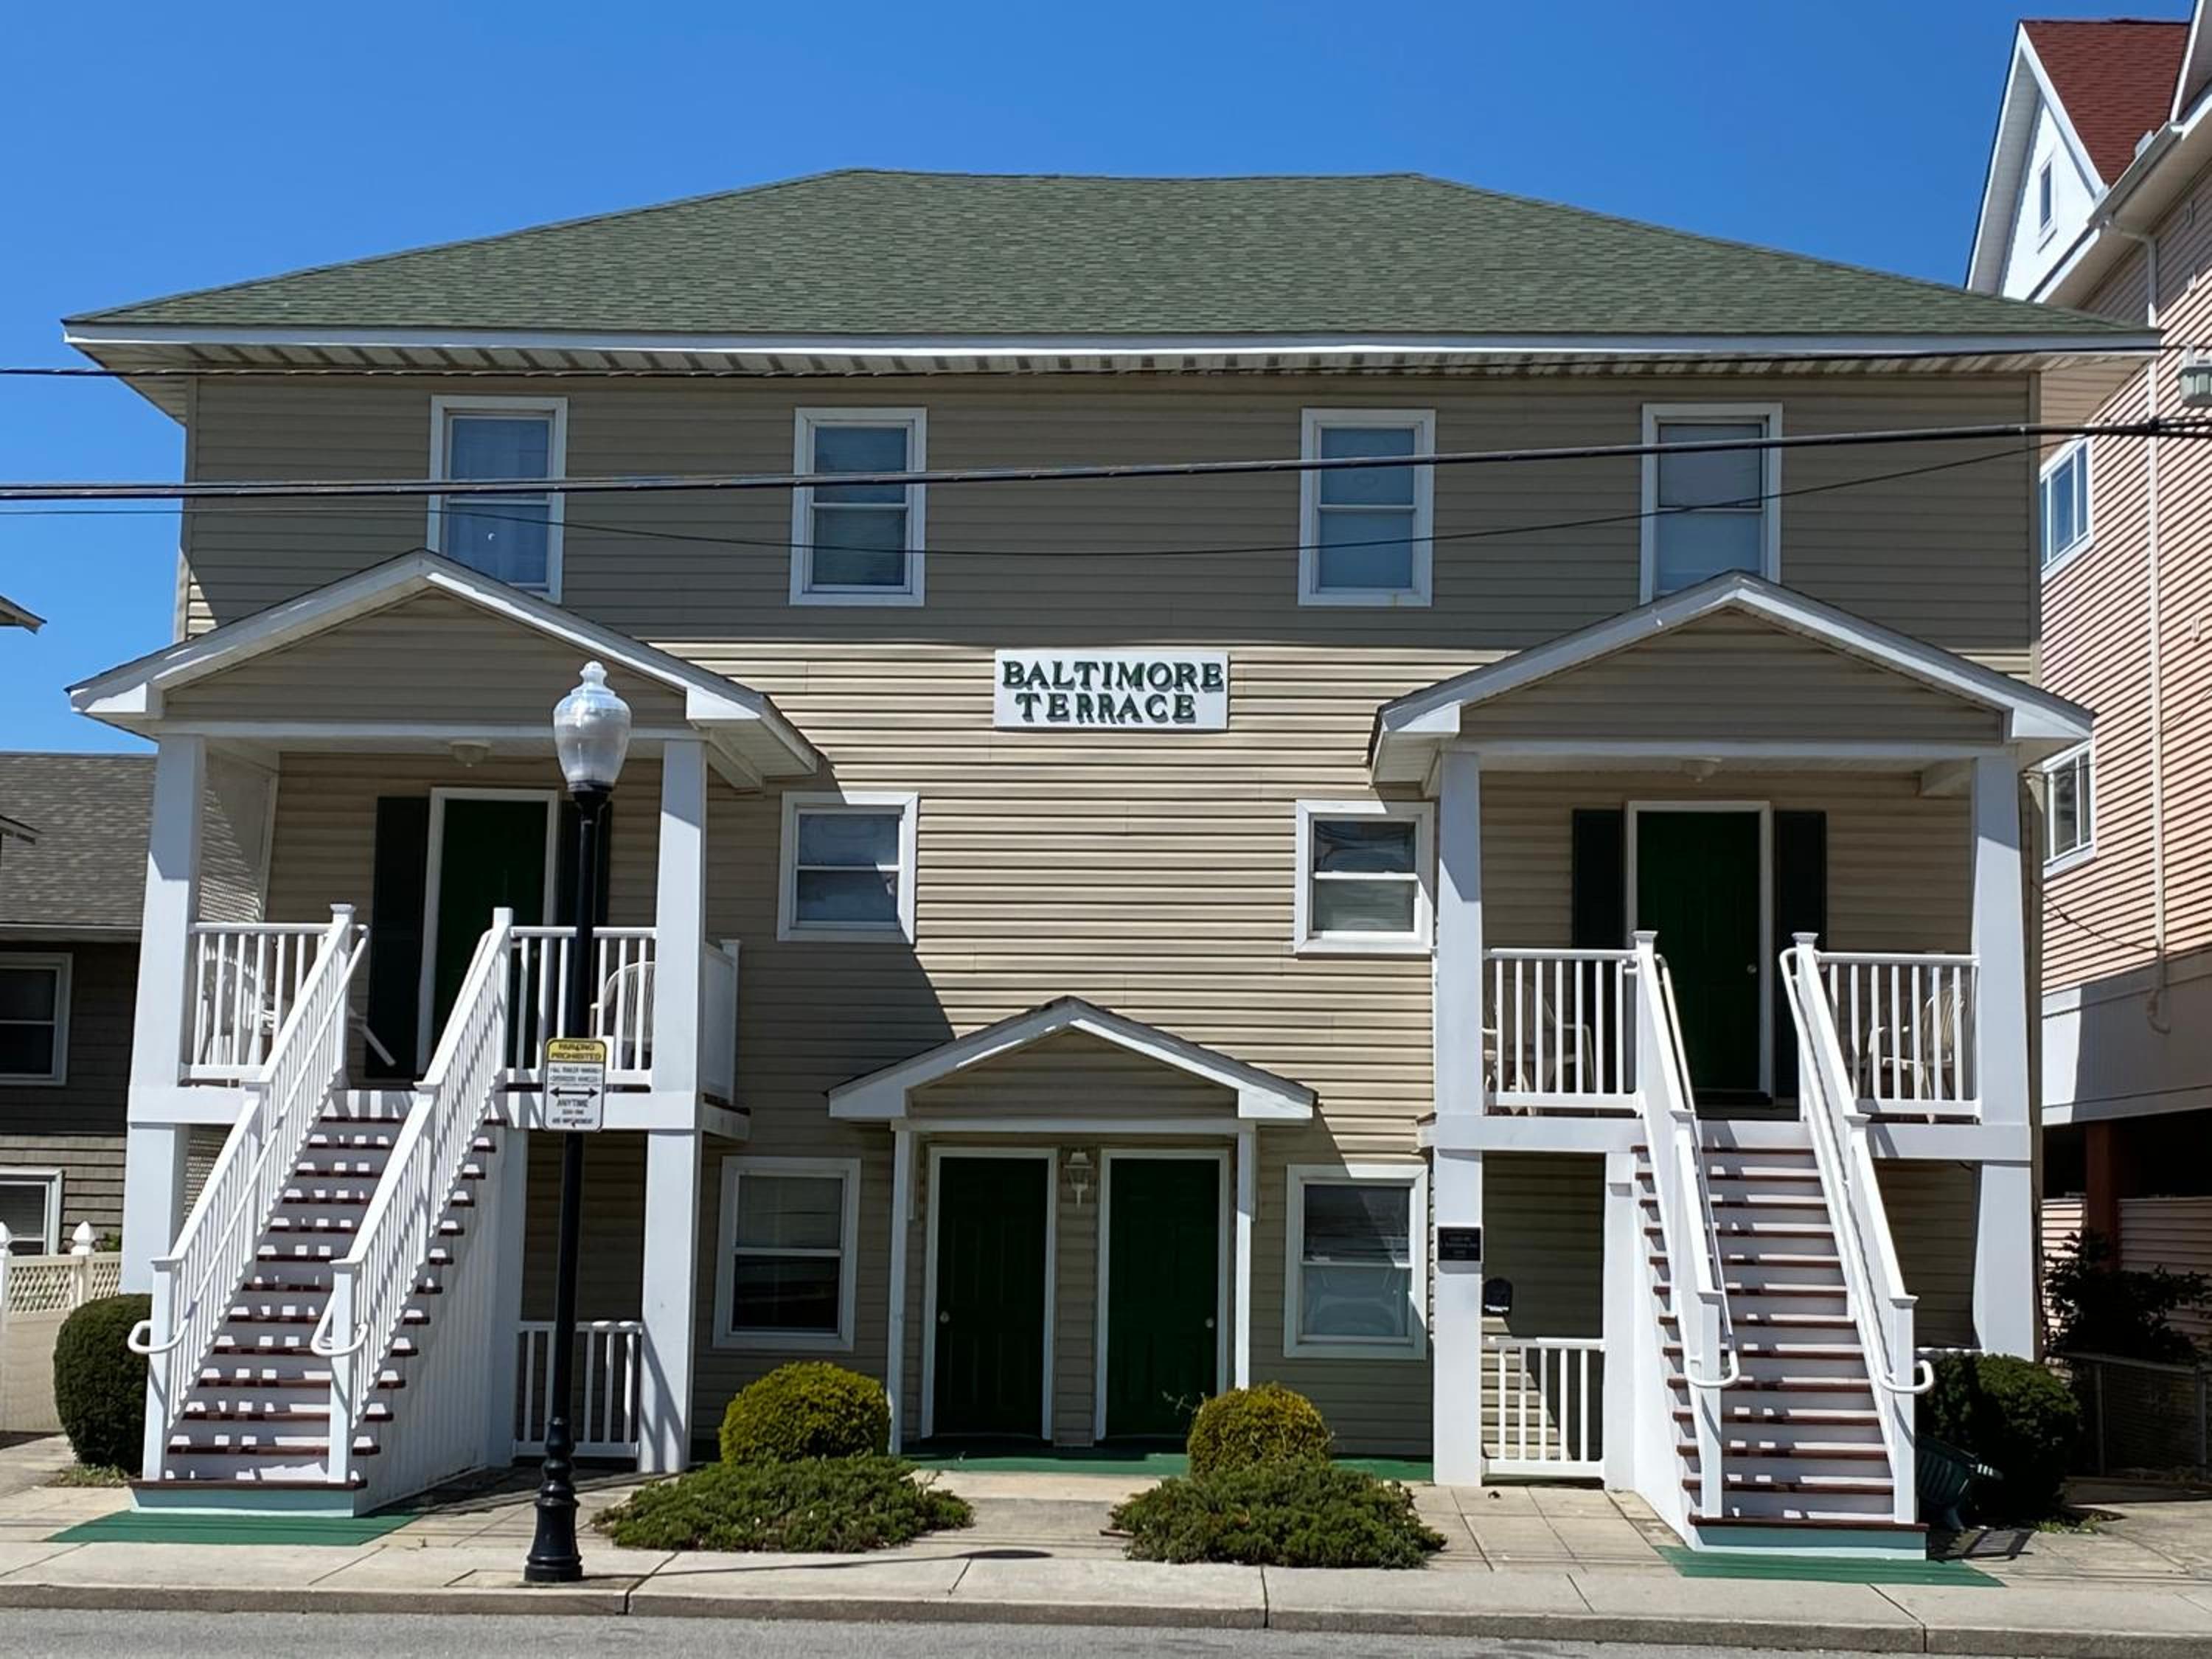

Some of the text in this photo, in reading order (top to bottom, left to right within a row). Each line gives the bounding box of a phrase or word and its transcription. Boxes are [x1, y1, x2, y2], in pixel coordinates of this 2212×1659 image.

[1002, 661, 1224, 692] BALTIMORE
[1015, 692, 1196, 724] TERRACE
[557, 1099, 588, 1107] ANYTIME
